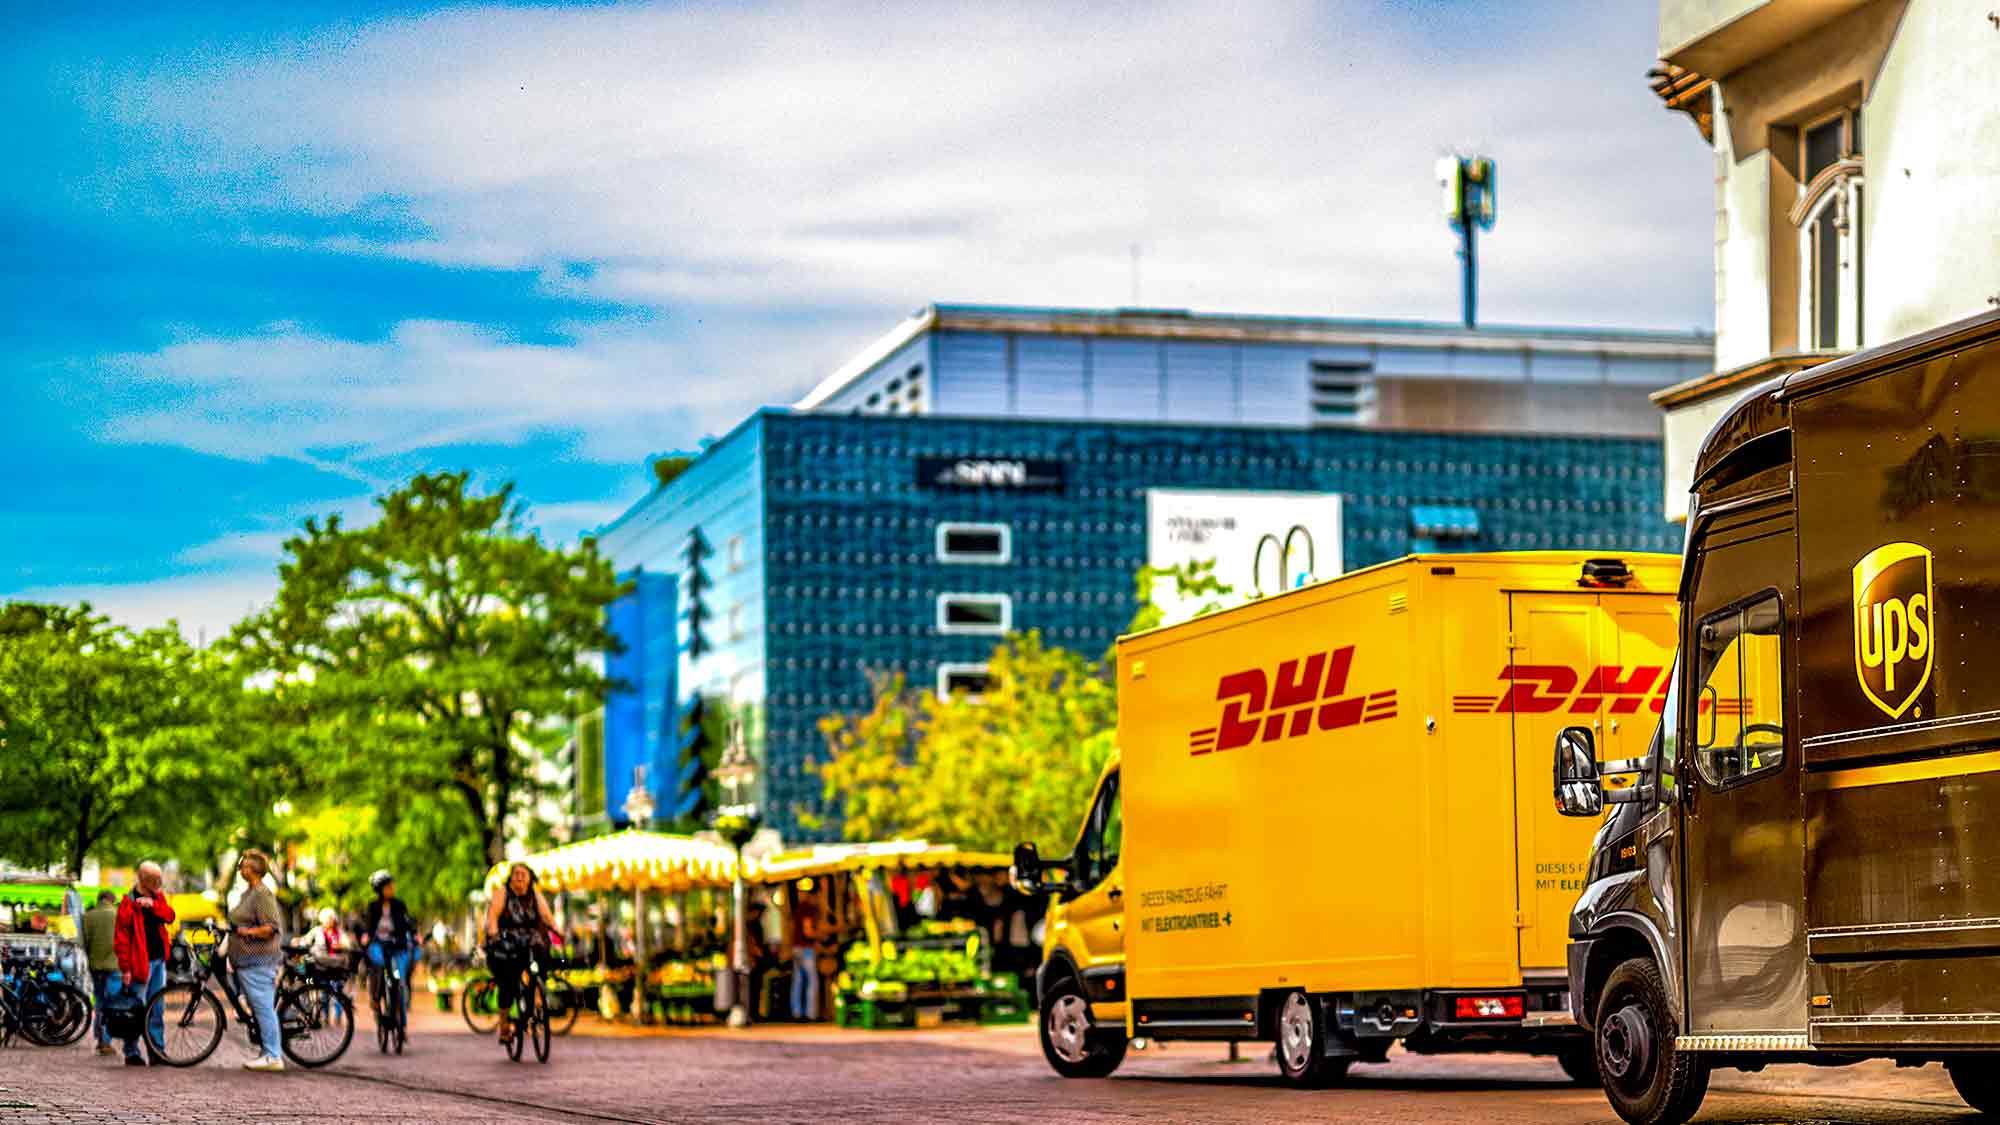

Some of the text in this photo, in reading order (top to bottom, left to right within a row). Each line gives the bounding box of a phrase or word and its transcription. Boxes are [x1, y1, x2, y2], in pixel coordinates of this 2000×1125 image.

[1860, 593, 1928, 692] ups
[1215, 645, 1367, 752] DHL
[1536, 863, 1576, 874] DIESES
[1536, 880, 1556, 889] MIT
